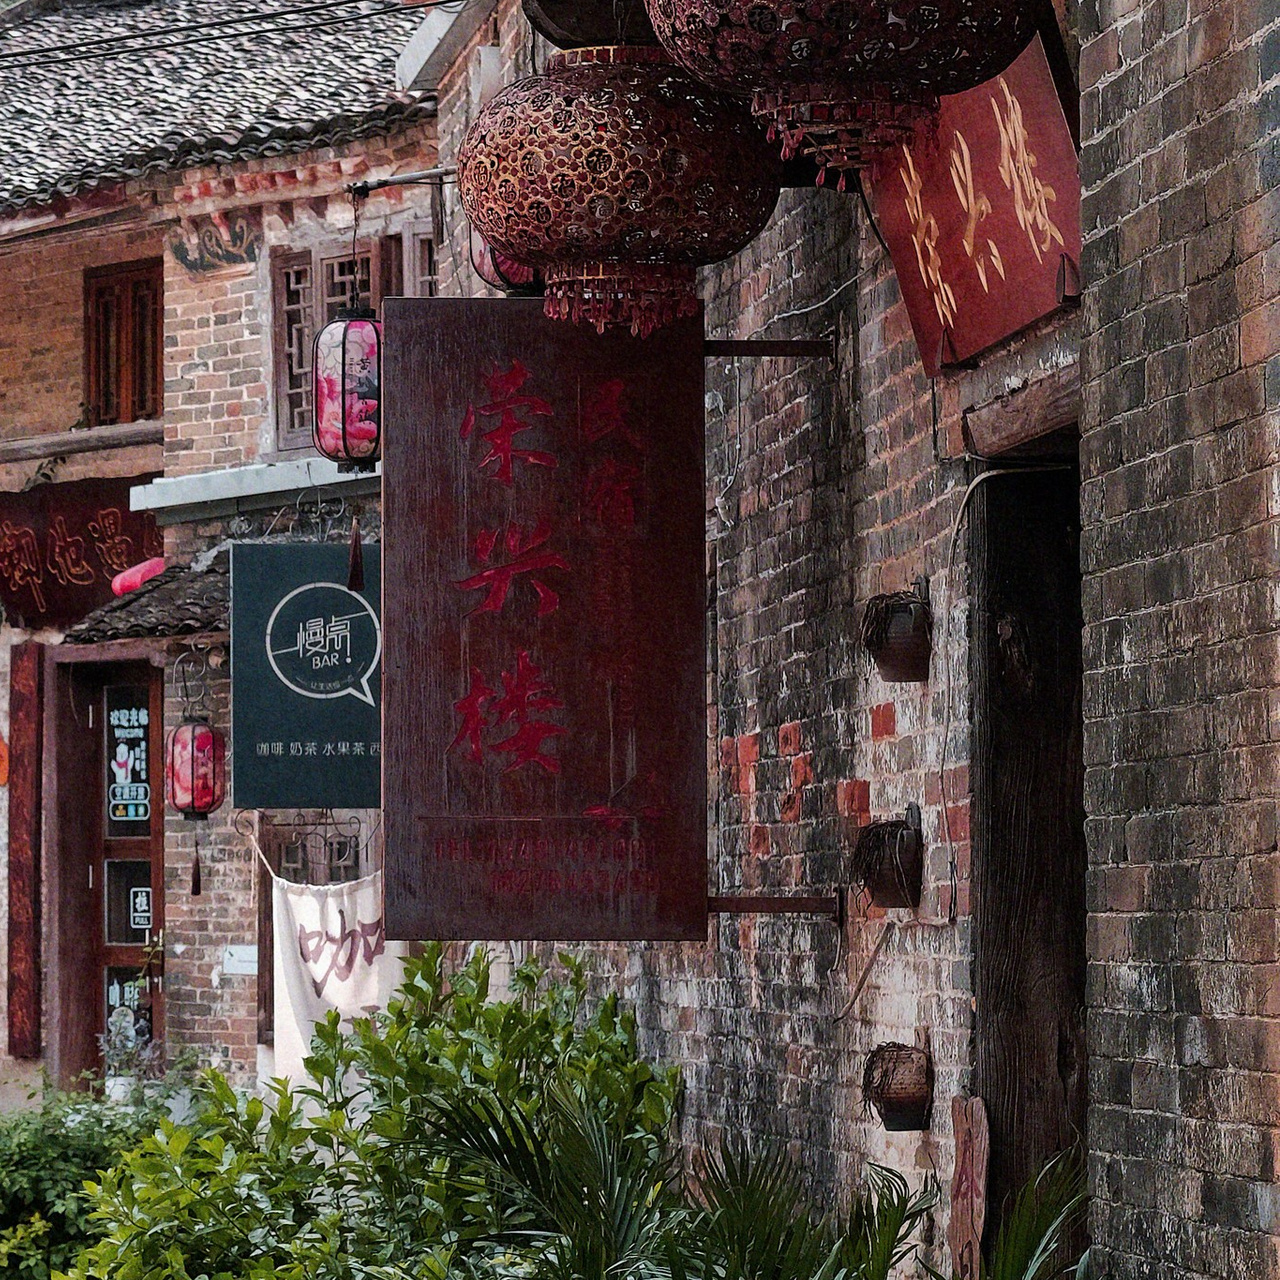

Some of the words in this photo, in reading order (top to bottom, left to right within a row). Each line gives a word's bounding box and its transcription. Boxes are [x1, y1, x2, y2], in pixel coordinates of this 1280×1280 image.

[447, 357, 572, 775] 荣兴楼
[312, 654, 339, 670] BAR
[109, 707, 149, 727] 欢迎光临
[256, 742, 284, 757] 咖啡
[289, 741, 318, 757] 奶茶
[322, 741, 365, 757] 水果茶
[135, 892, 149, 913] 拉
